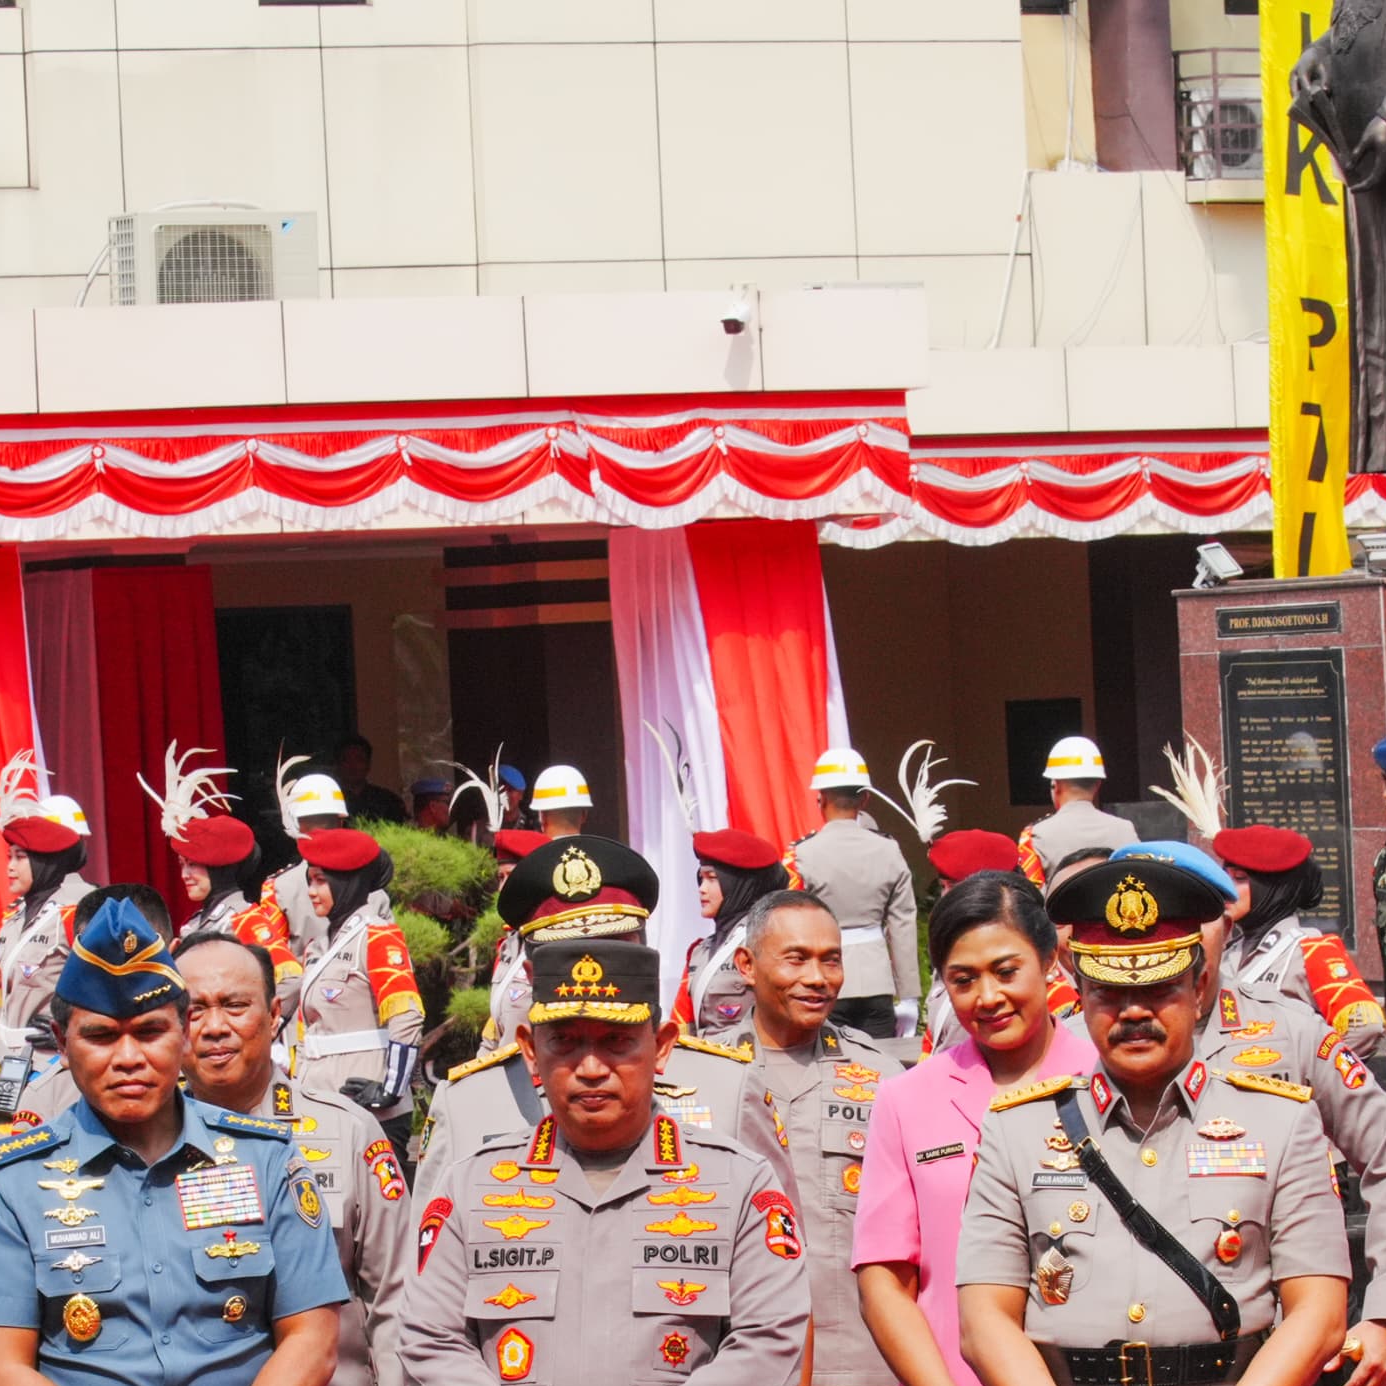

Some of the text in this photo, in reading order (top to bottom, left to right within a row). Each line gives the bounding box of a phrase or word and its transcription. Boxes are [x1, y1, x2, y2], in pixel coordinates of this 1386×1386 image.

[828, 1104, 871, 1123] POL
[474, 1246, 555, 1269] L.SIGIT.P
[643, 1244, 719, 1266] POLRI
